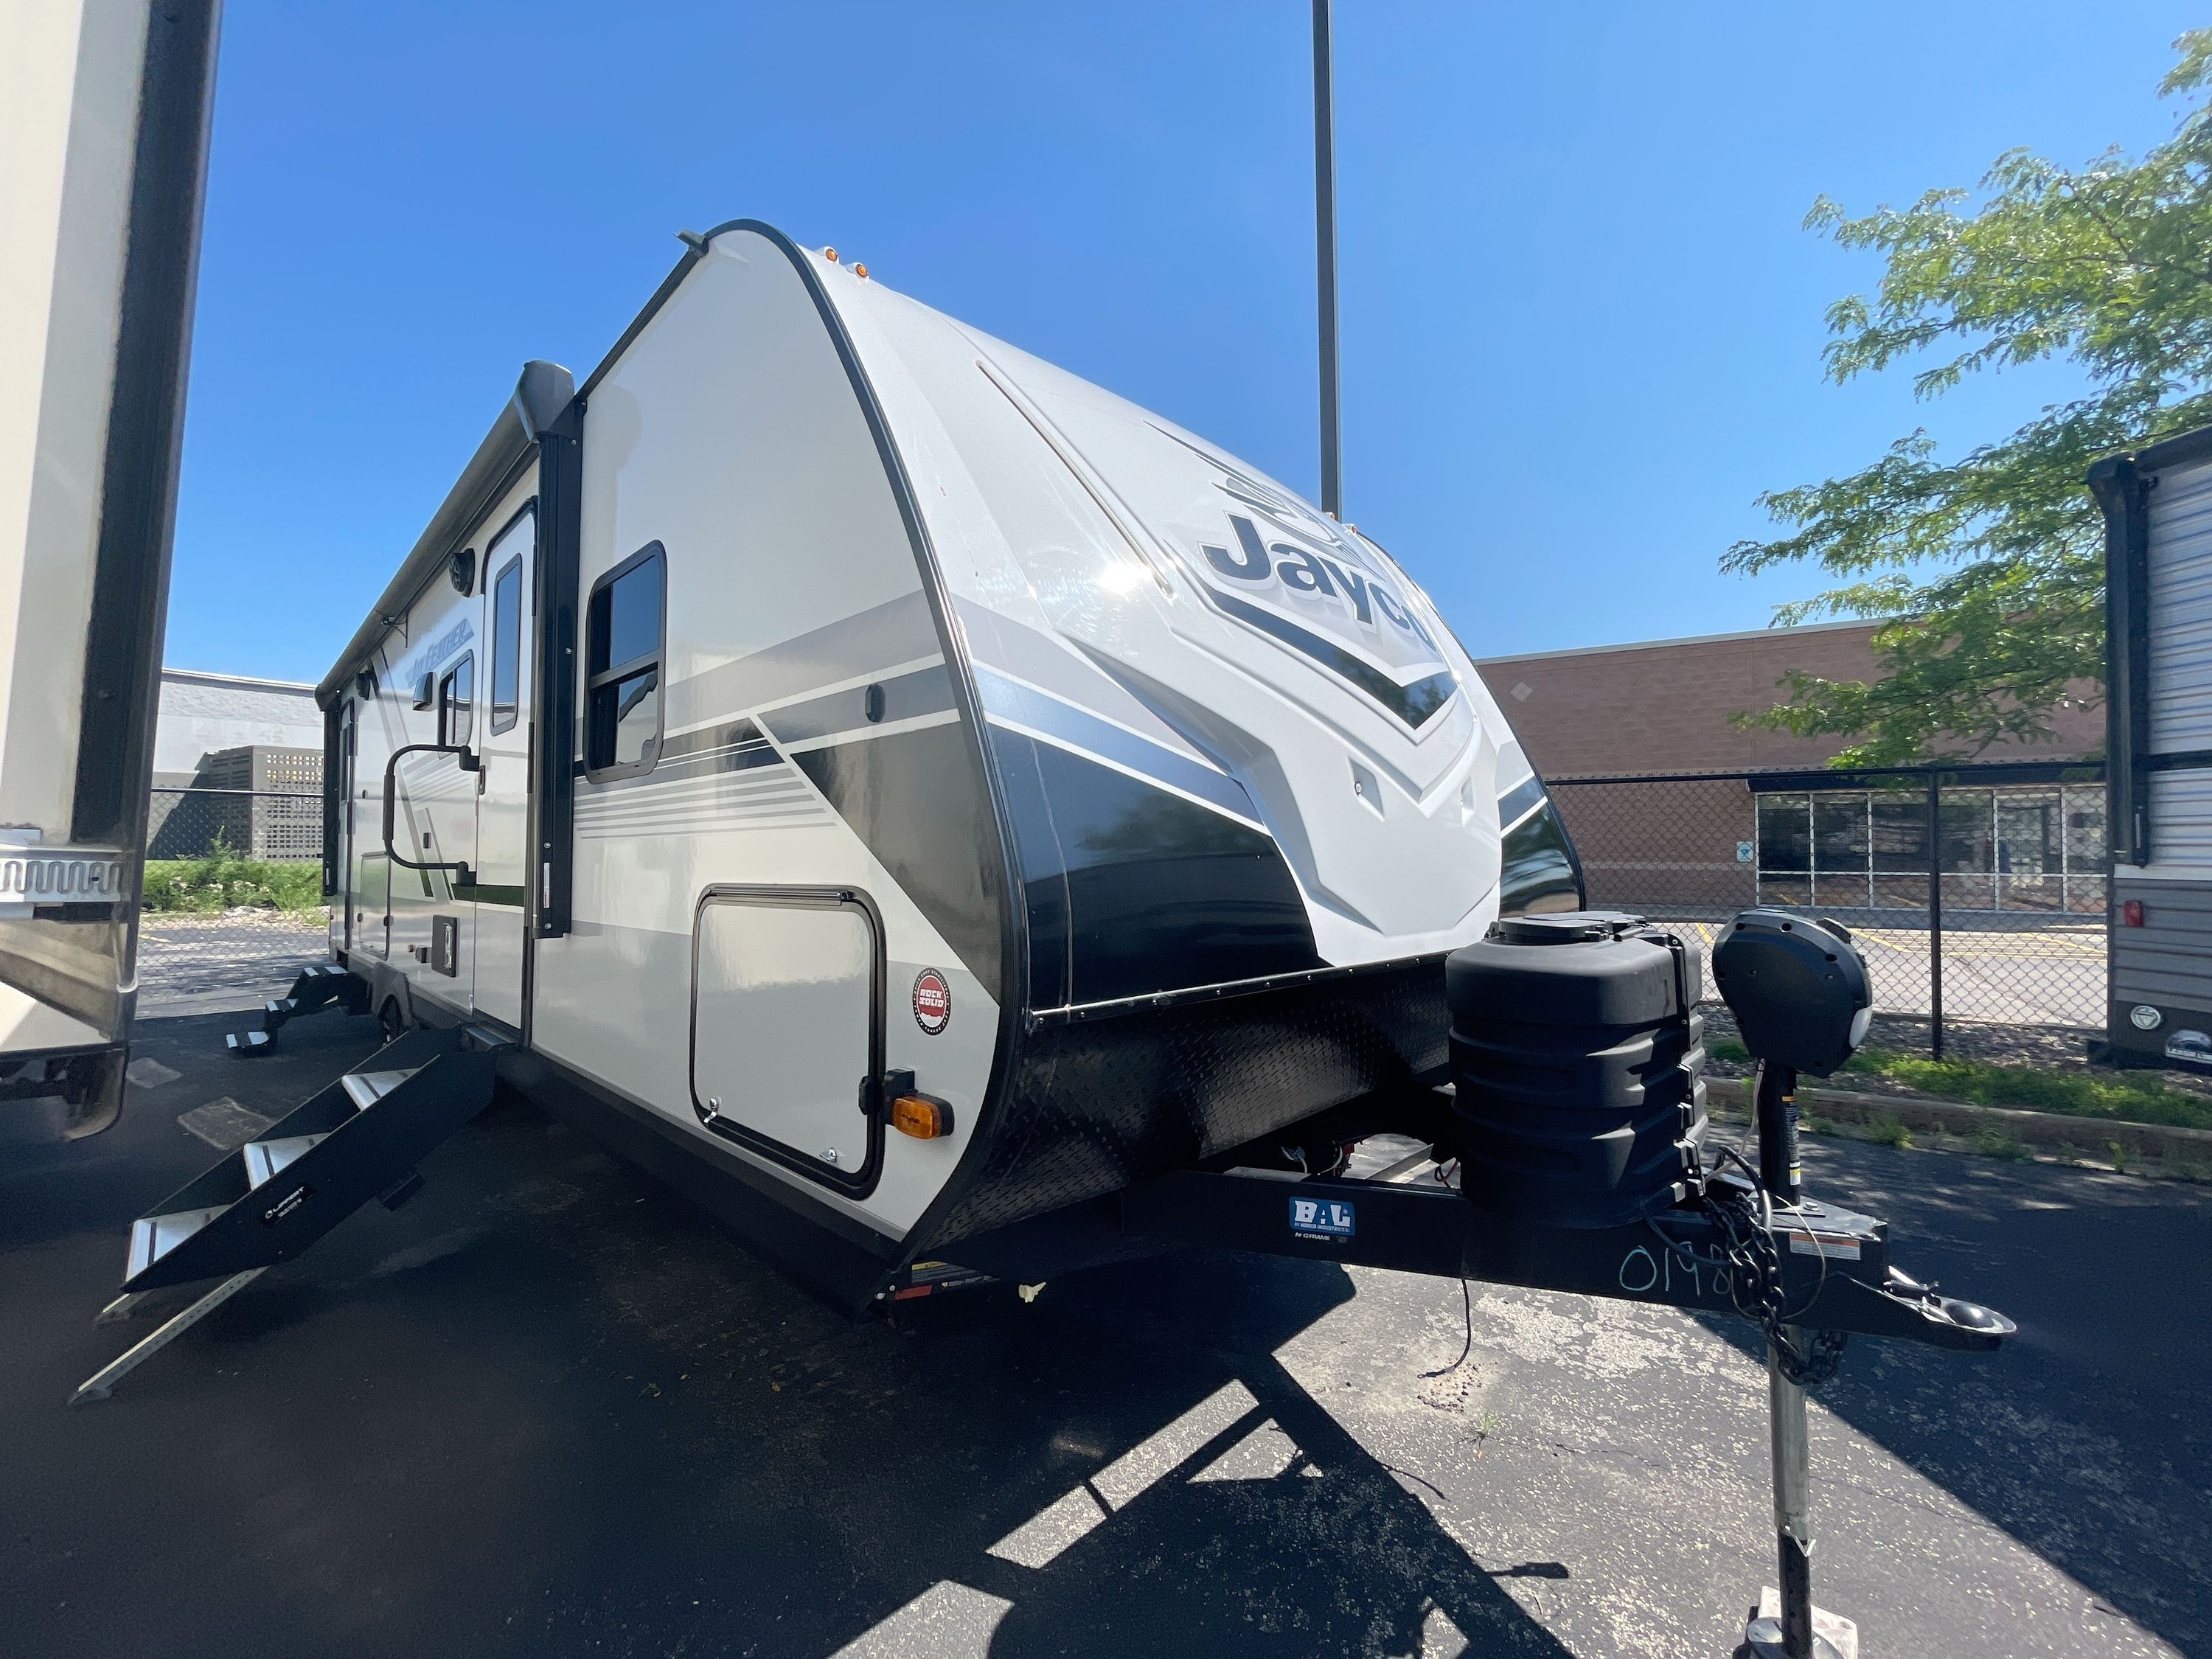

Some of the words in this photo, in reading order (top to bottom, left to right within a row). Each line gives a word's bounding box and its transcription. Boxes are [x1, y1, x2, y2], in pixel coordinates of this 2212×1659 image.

[1201, 512, 1437, 652] Jayco
[919, 996, 945, 1008] SOLID
[920, 988, 943, 999] ROCK
[1294, 1200, 1351, 1228] BAL
